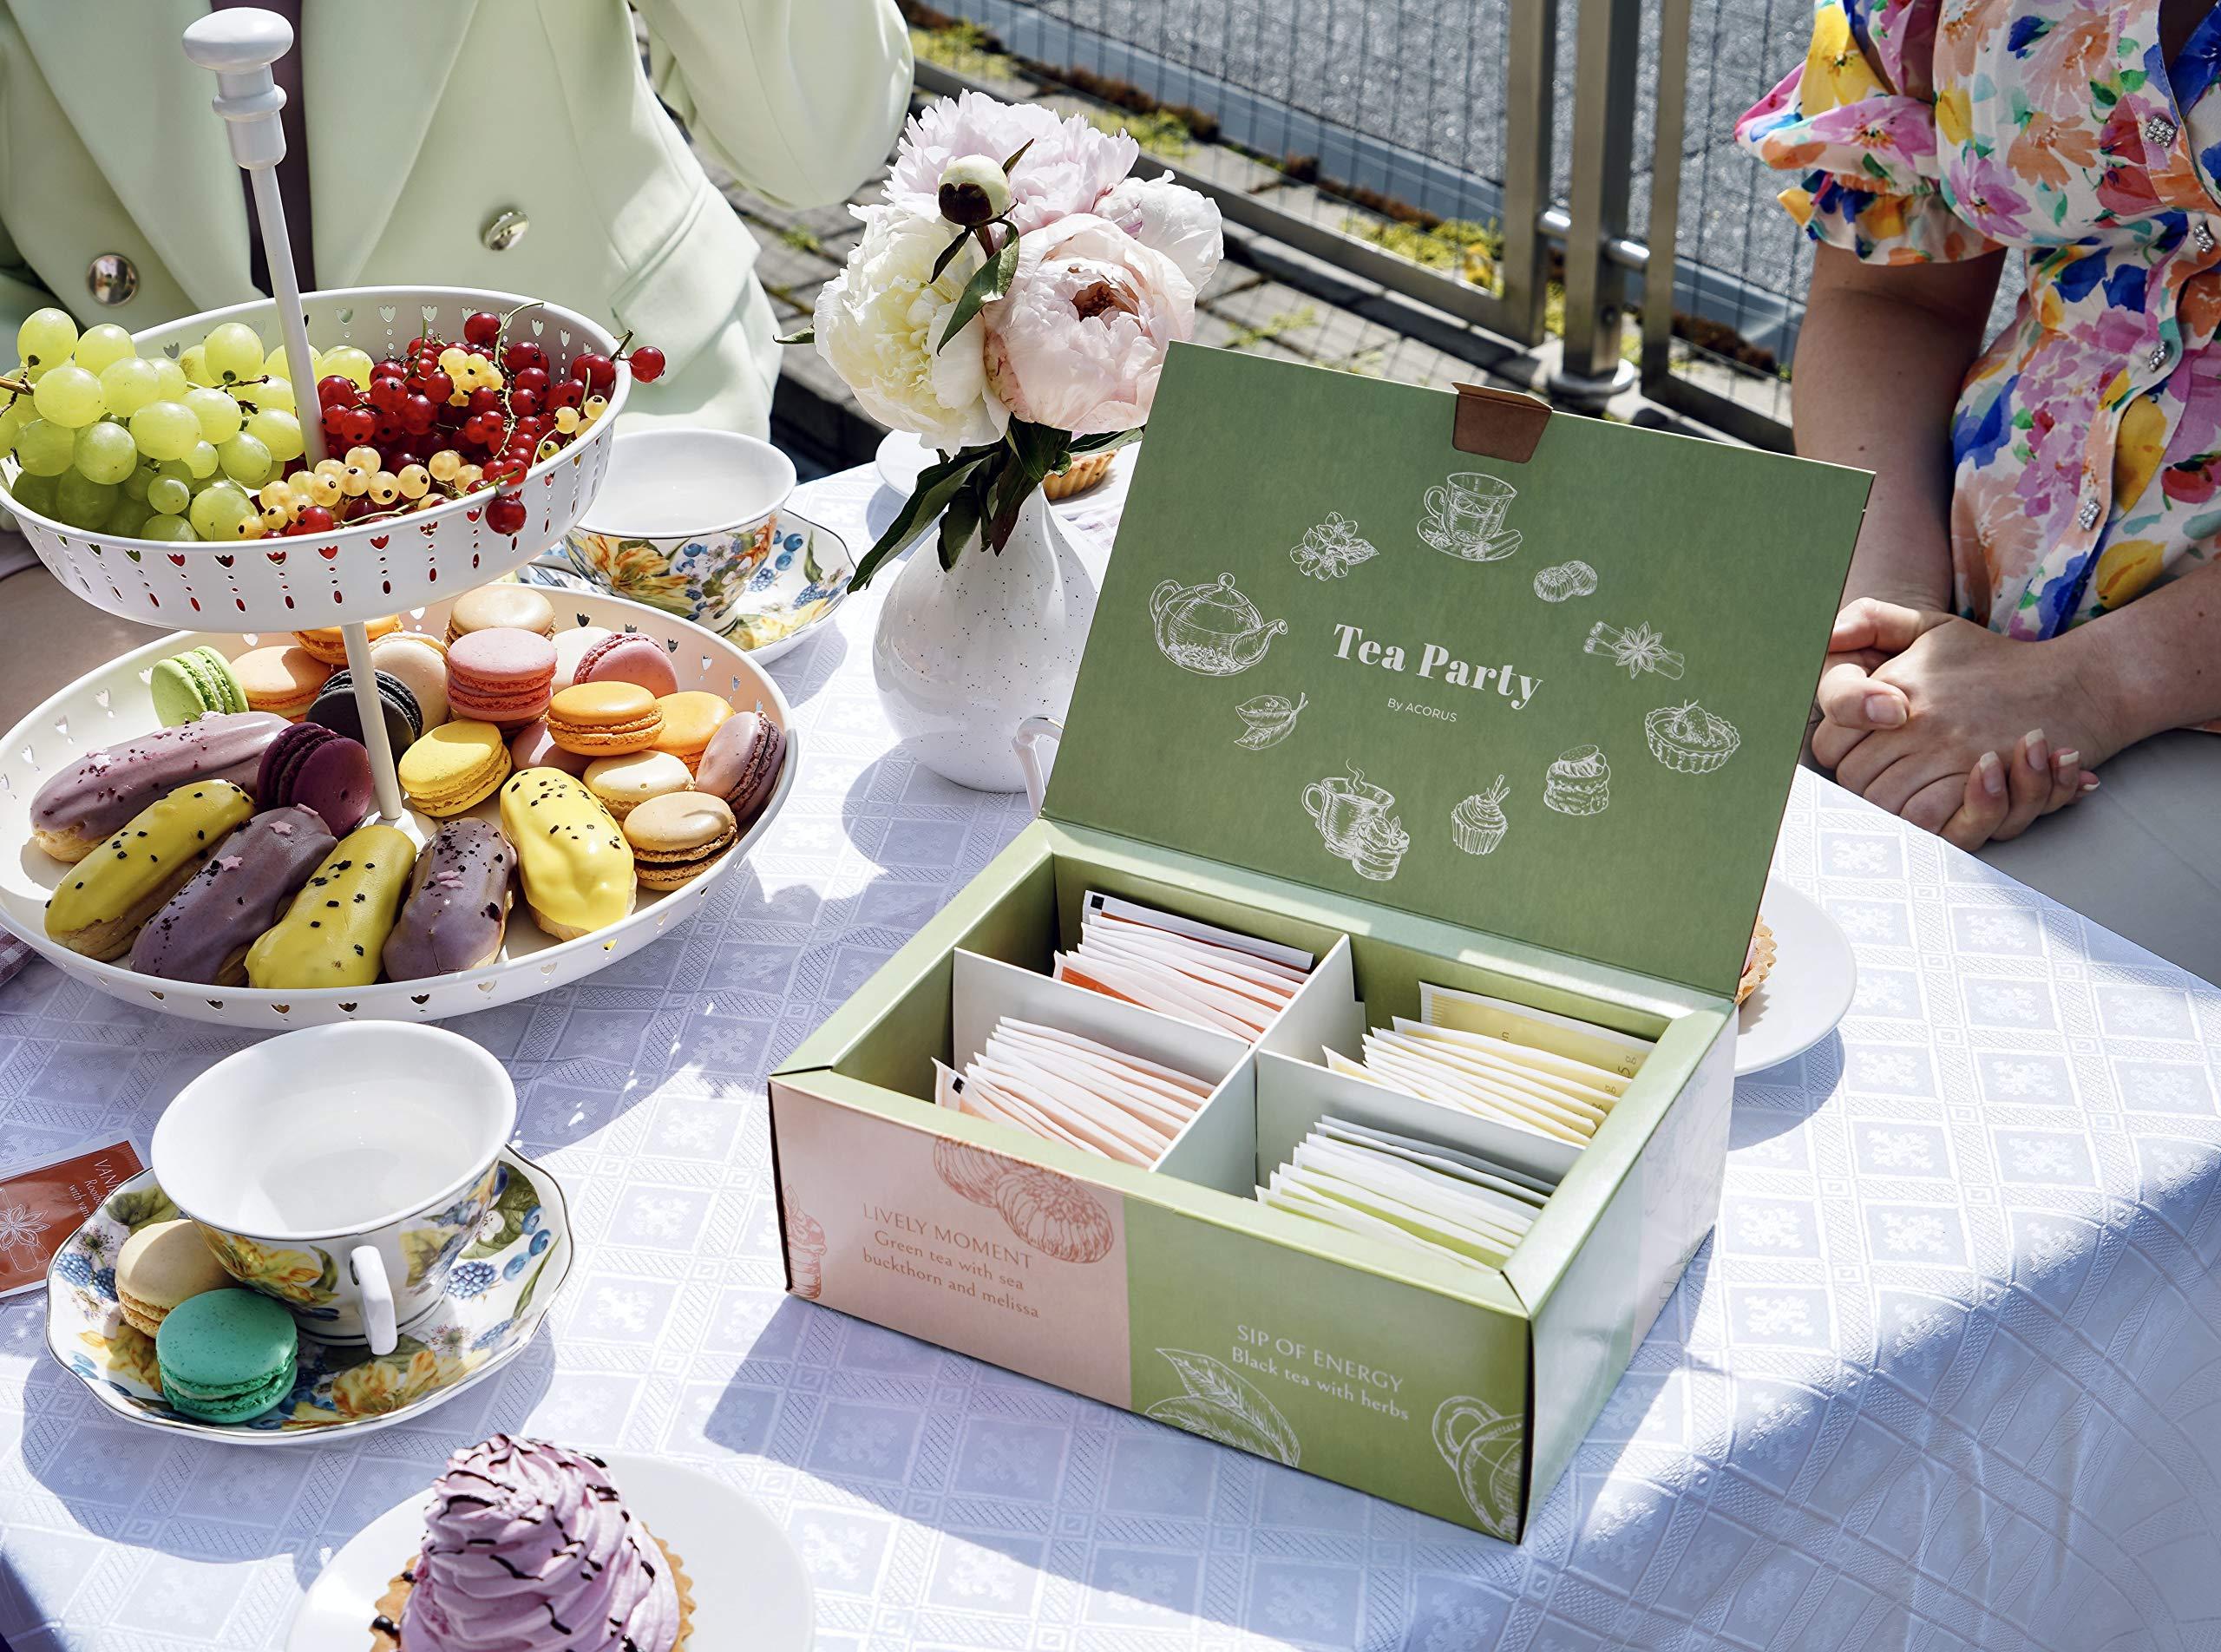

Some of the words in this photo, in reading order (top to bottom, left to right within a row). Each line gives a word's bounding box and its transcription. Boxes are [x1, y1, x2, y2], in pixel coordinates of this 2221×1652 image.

[1333, 623, 1405, 672] Tea
[1416, 643, 1543, 710] Party
[1387, 698, 1403, 711] By
[1405, 703, 1458, 723] ACORUS
[69, 1184, 87, 1201] with
[863, 1203, 927, 1236] LIVELY
[934, 1225, 1032, 1269] MOMENT
[875, 1229, 923, 1257] Green
[930, 1250, 953, 1267] tea
[959, 1261, 993, 1280] with
[999, 1275, 1024, 1290] sea
[863, 1247, 942, 1285] buckthorn
[948, 1280, 976, 1297] and
[982, 1290, 1040, 1318] melissa
[1232, 1346, 1278, 1375] Black
[1285, 1368, 1310, 1386] tea
[1316, 1380, 1354, 1402] with
[1361, 1389, 1409, 1421] herbs
[1237, 1324, 1269, 1347] SIP
[1275, 1338, 1306, 1360] OF
[1314, 1349, 1404, 1393] ENERGY
